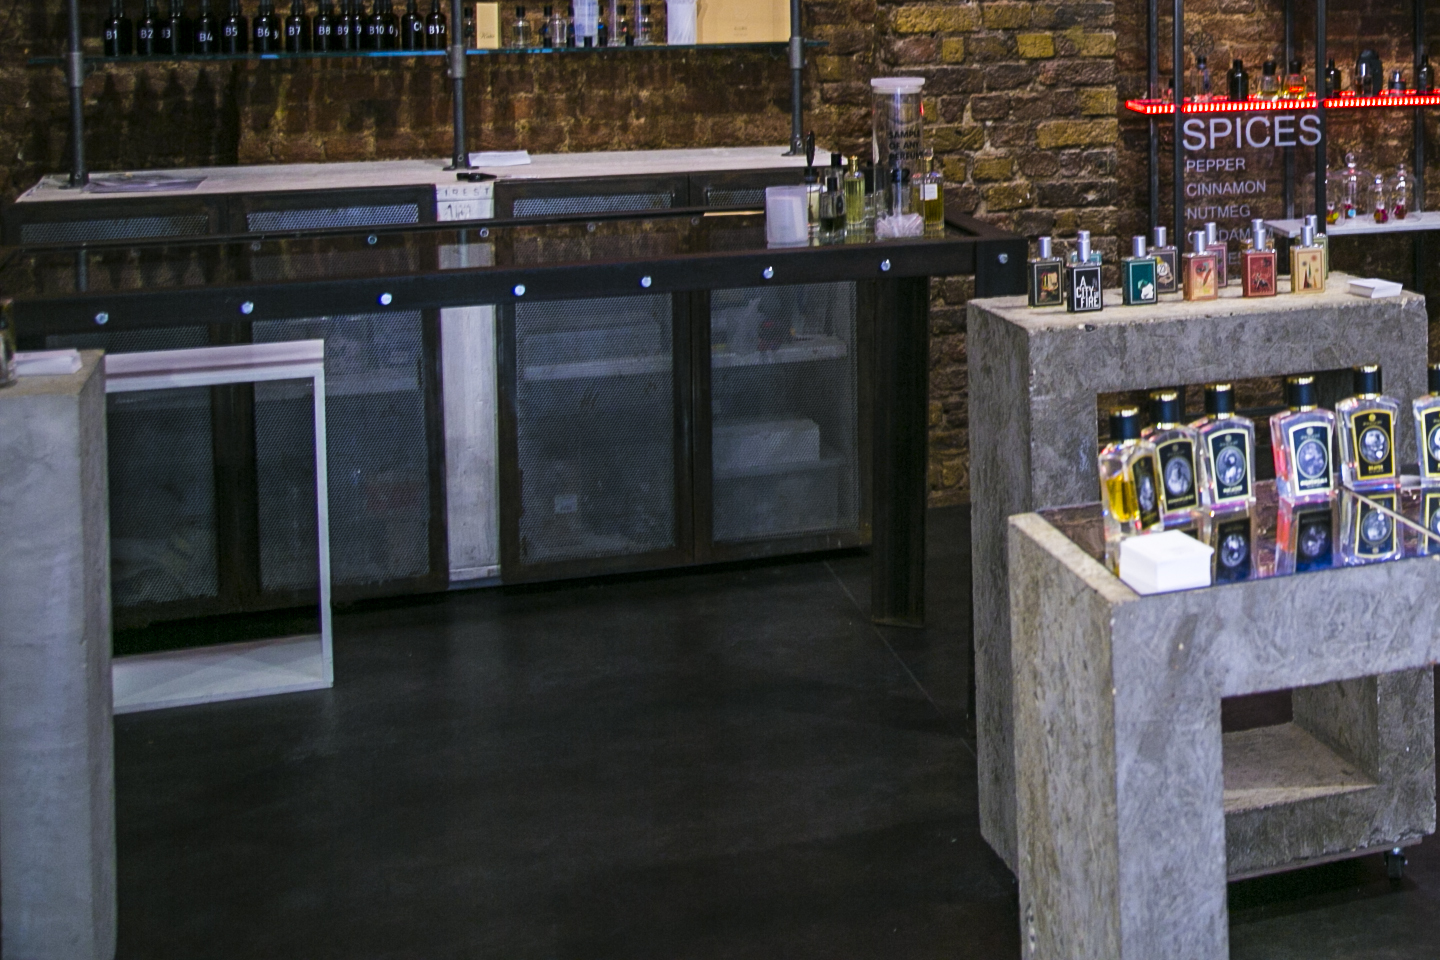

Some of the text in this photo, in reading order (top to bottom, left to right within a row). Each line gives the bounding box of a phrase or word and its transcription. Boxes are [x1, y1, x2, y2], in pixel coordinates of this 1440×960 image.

[106, 29, 118, 40] B1
[140, 29, 153, 39] B2
[225, 26, 238, 37] B5
[257, 27, 270, 37] B6
[288, 26, 301, 36] B7
[319, 25, 331, 35] B8
[337, 25, 349, 35] B9
[369, 25, 384, 35] B10
[429, 25, 445, 35] B12
[200, 33, 213, 42] B4
[1183, 114, 1322, 151] SPICES
[889, 140, 921, 150] OF ANY
[1186, 157, 1246, 173] PEPPER
[1186, 179, 1267, 197] CINNAMON
[1187, 204, 1250, 220] NUTMEG
[1076, 286, 1094, 299] CITY
[1080, 295, 1099, 308] FIRE
